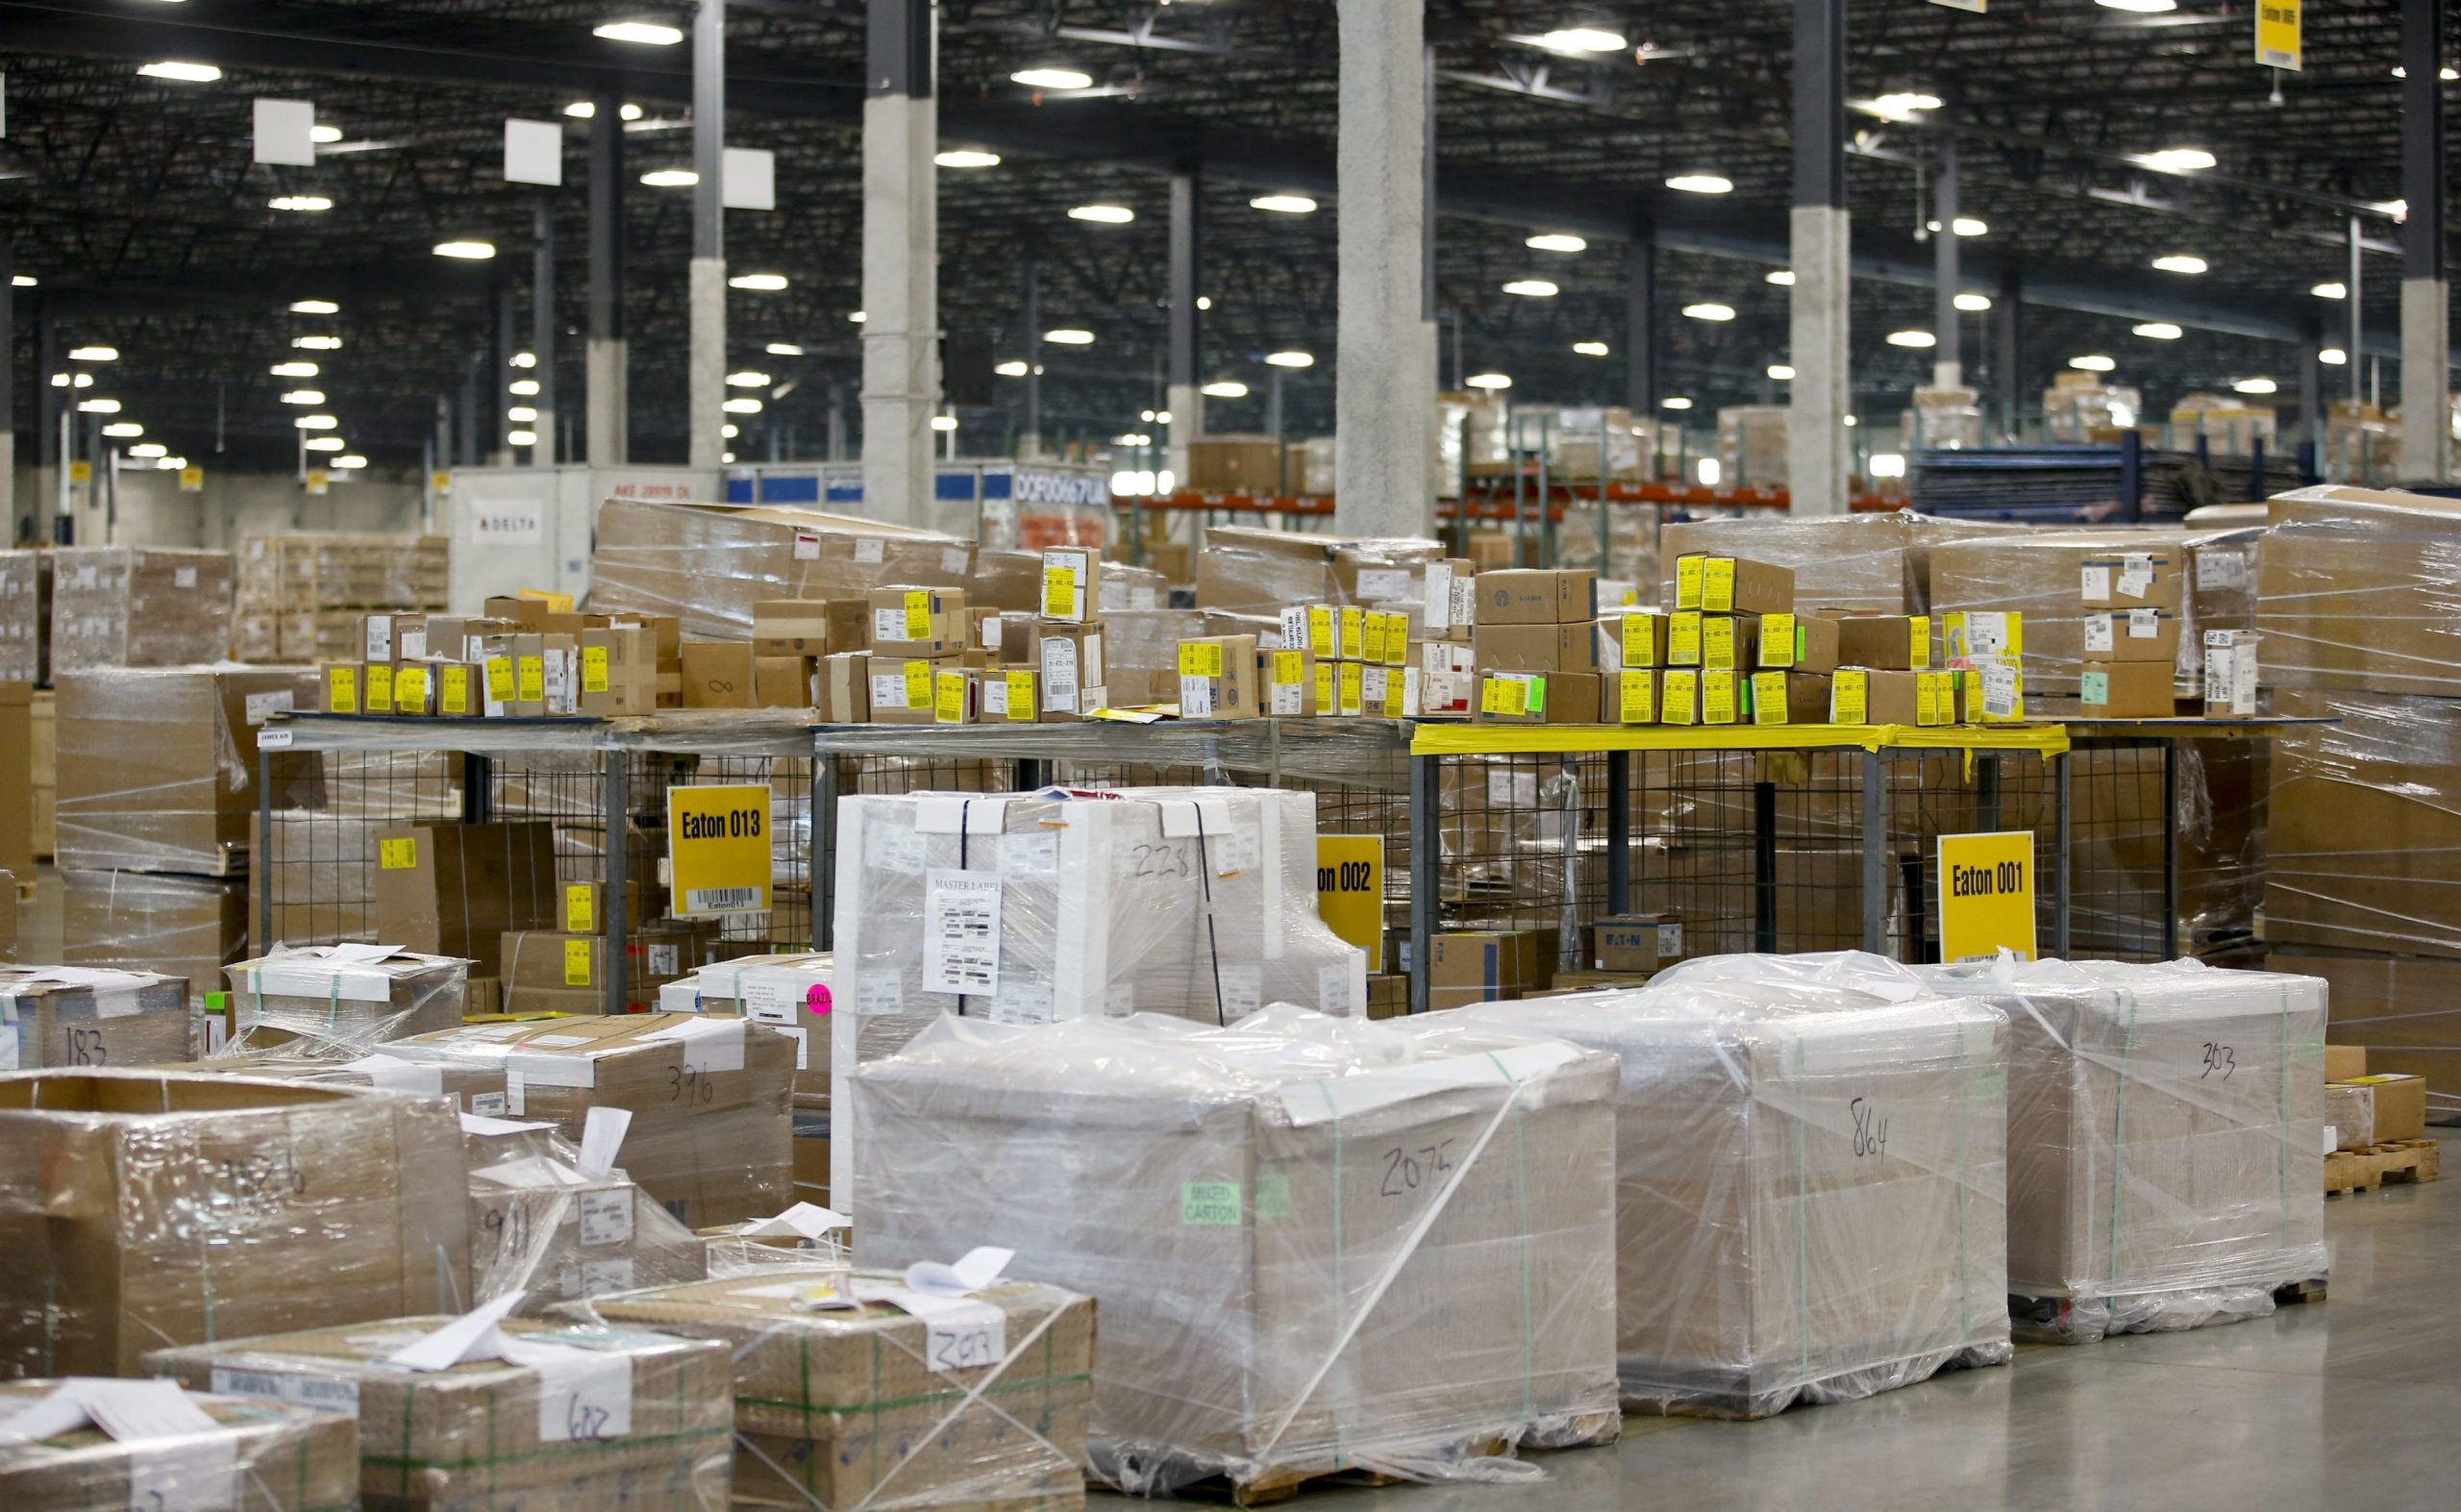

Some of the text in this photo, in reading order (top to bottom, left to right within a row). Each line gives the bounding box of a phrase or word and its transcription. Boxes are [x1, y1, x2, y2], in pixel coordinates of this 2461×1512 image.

[491, 516, 535, 532] DELTA
[683, 809, 760, 839] Eaton 013
[1133, 844, 1188, 878] 228
[935, 879, 1001, 892] MASTER LABEL
[1340, 861, 1371, 892] 002
[1952, 861, 2023, 897] Eaton 001
[708, 901, 744, 909] Eaton013
[806, 992, 833, 1005] BRAZIL
[66, 1028, 107, 1066] 183
[668, 1061, 712, 1107] 396
[1851, 1097, 1887, 1165] 864
[1190, 1185, 1230, 1201] MIXED
[1184, 1204, 1237, 1222] CARTON
